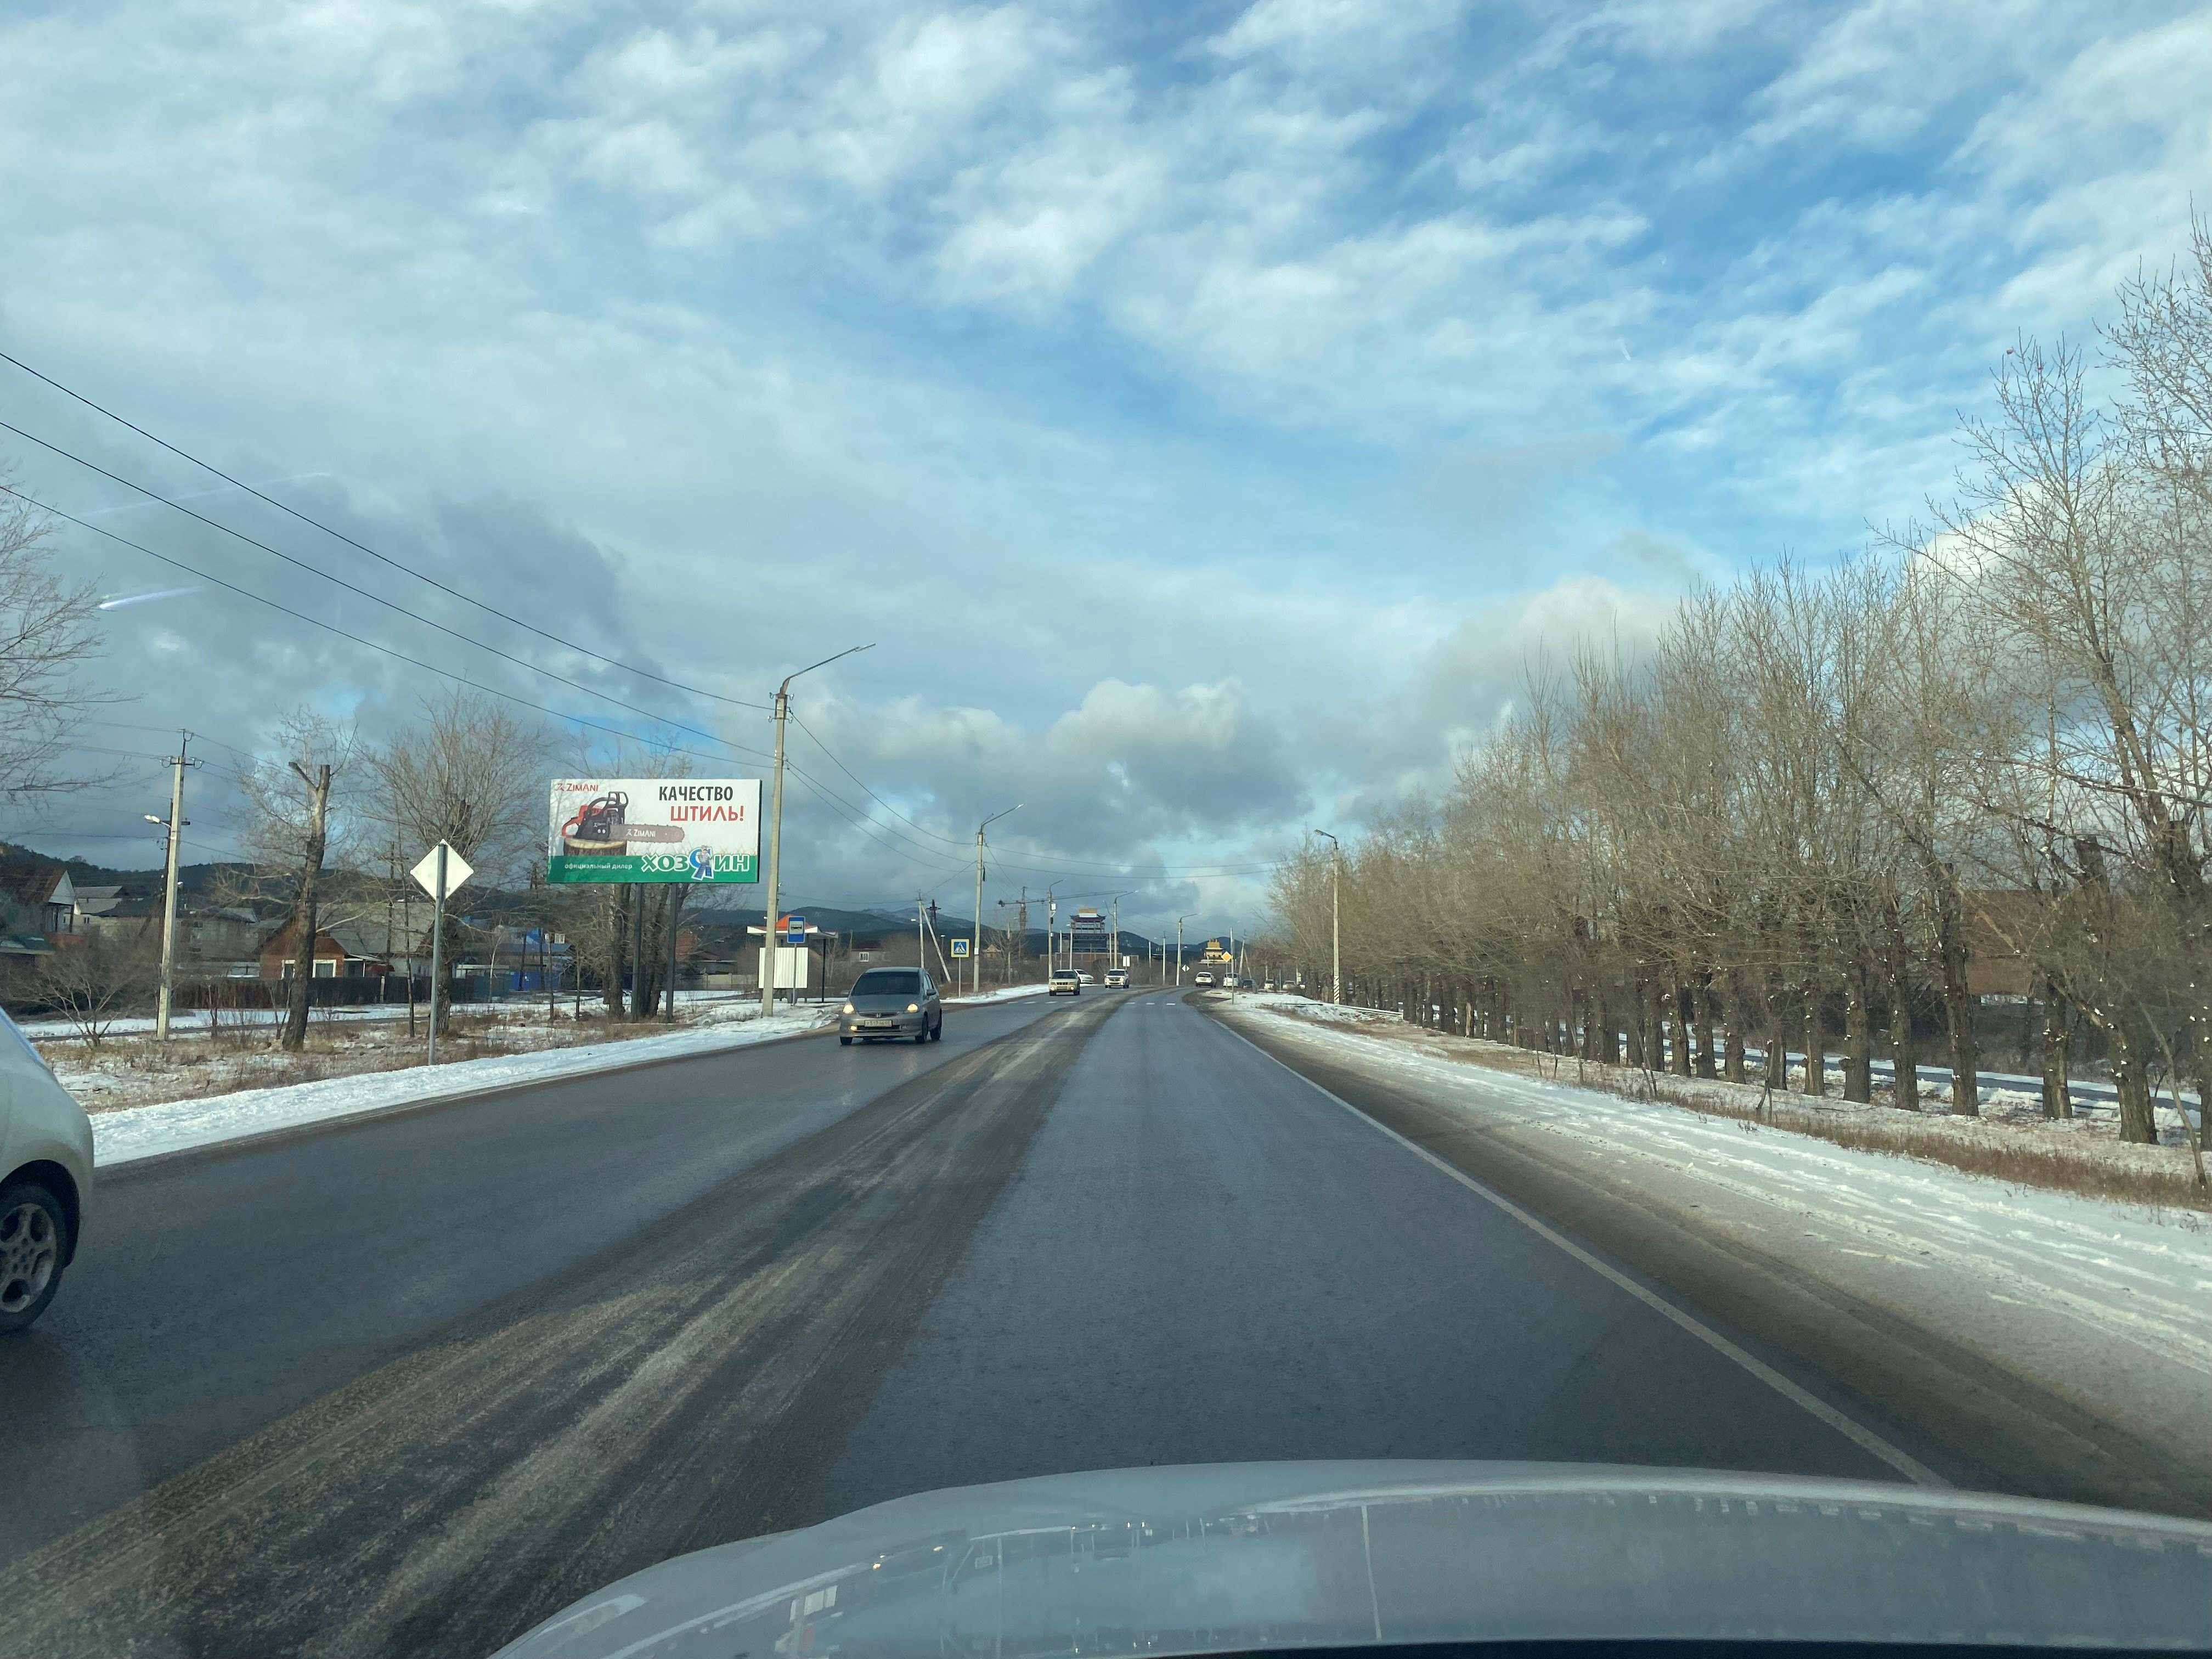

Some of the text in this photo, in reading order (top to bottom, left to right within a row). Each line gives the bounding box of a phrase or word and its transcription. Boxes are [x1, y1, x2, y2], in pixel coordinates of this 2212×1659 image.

[659, 786, 733, 801] КАЧЕСТВО
[670, 805, 744, 821] ШТИЛЬ!
[641, 847, 751, 881] ХОЗЯИН
